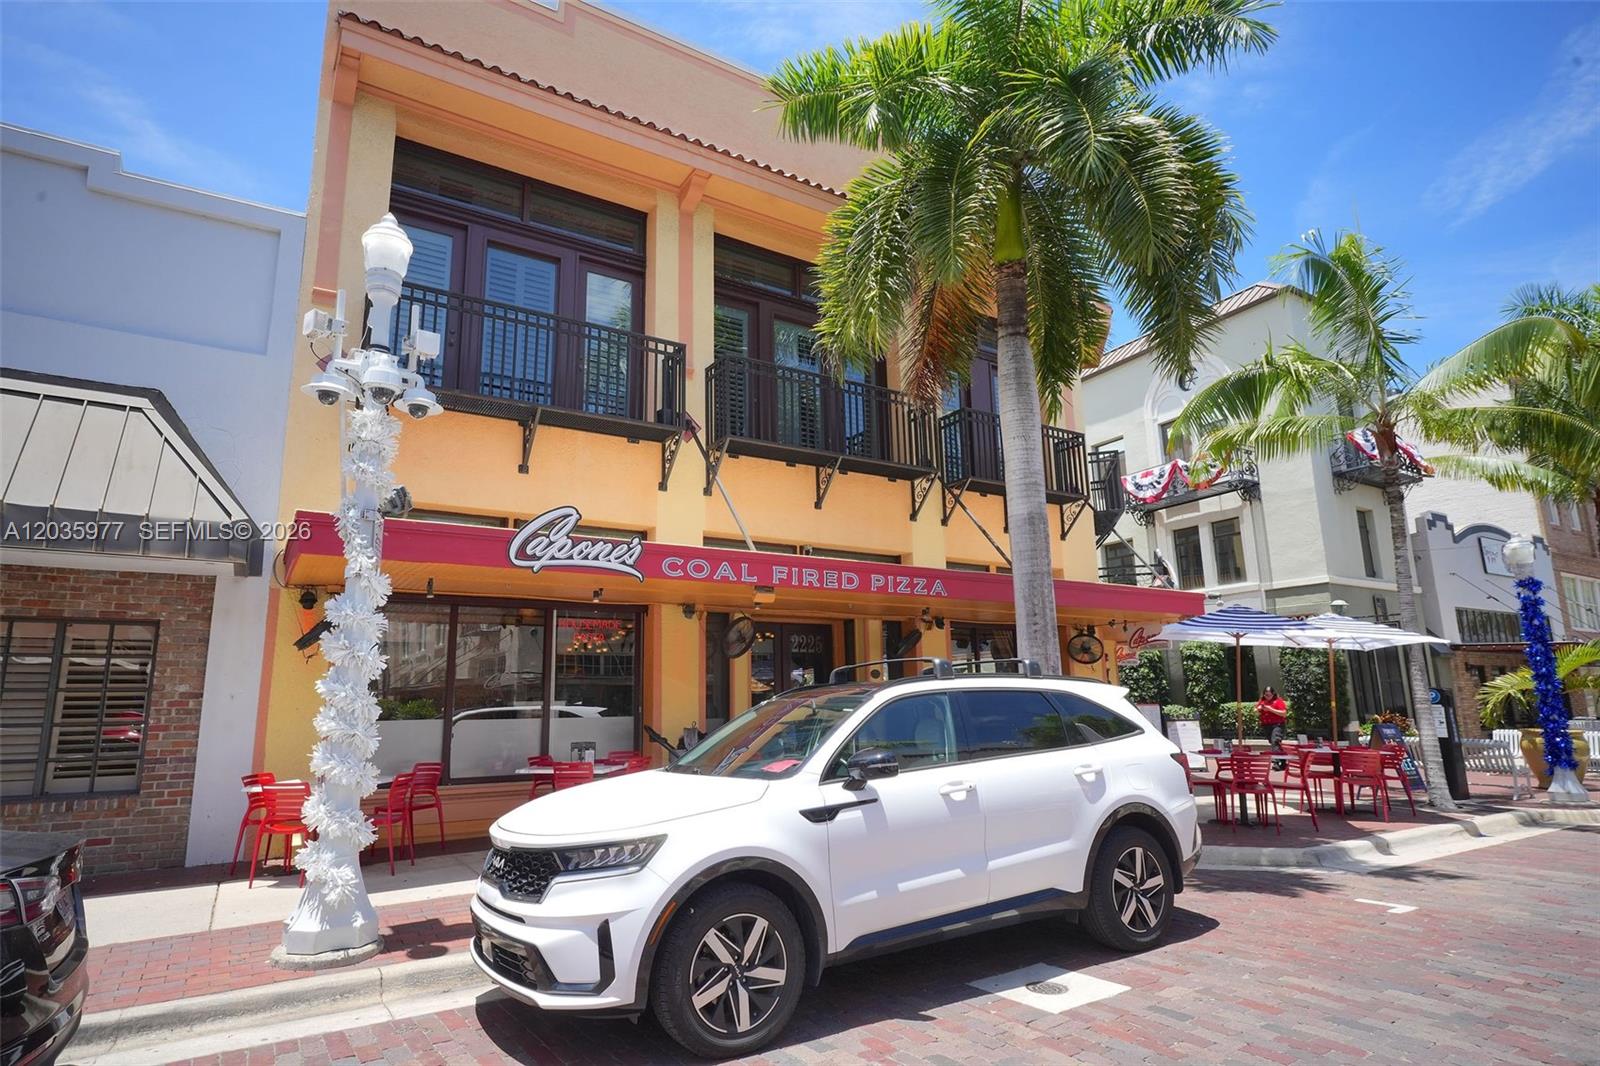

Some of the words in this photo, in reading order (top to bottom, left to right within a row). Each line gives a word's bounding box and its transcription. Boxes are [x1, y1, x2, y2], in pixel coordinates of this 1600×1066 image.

[508, 505, 645, 583] Capone's
[661, 556, 758, 583] COAL
[771, 565, 860, 591] FIRED
[870, 574, 948, 597] PIZZA
